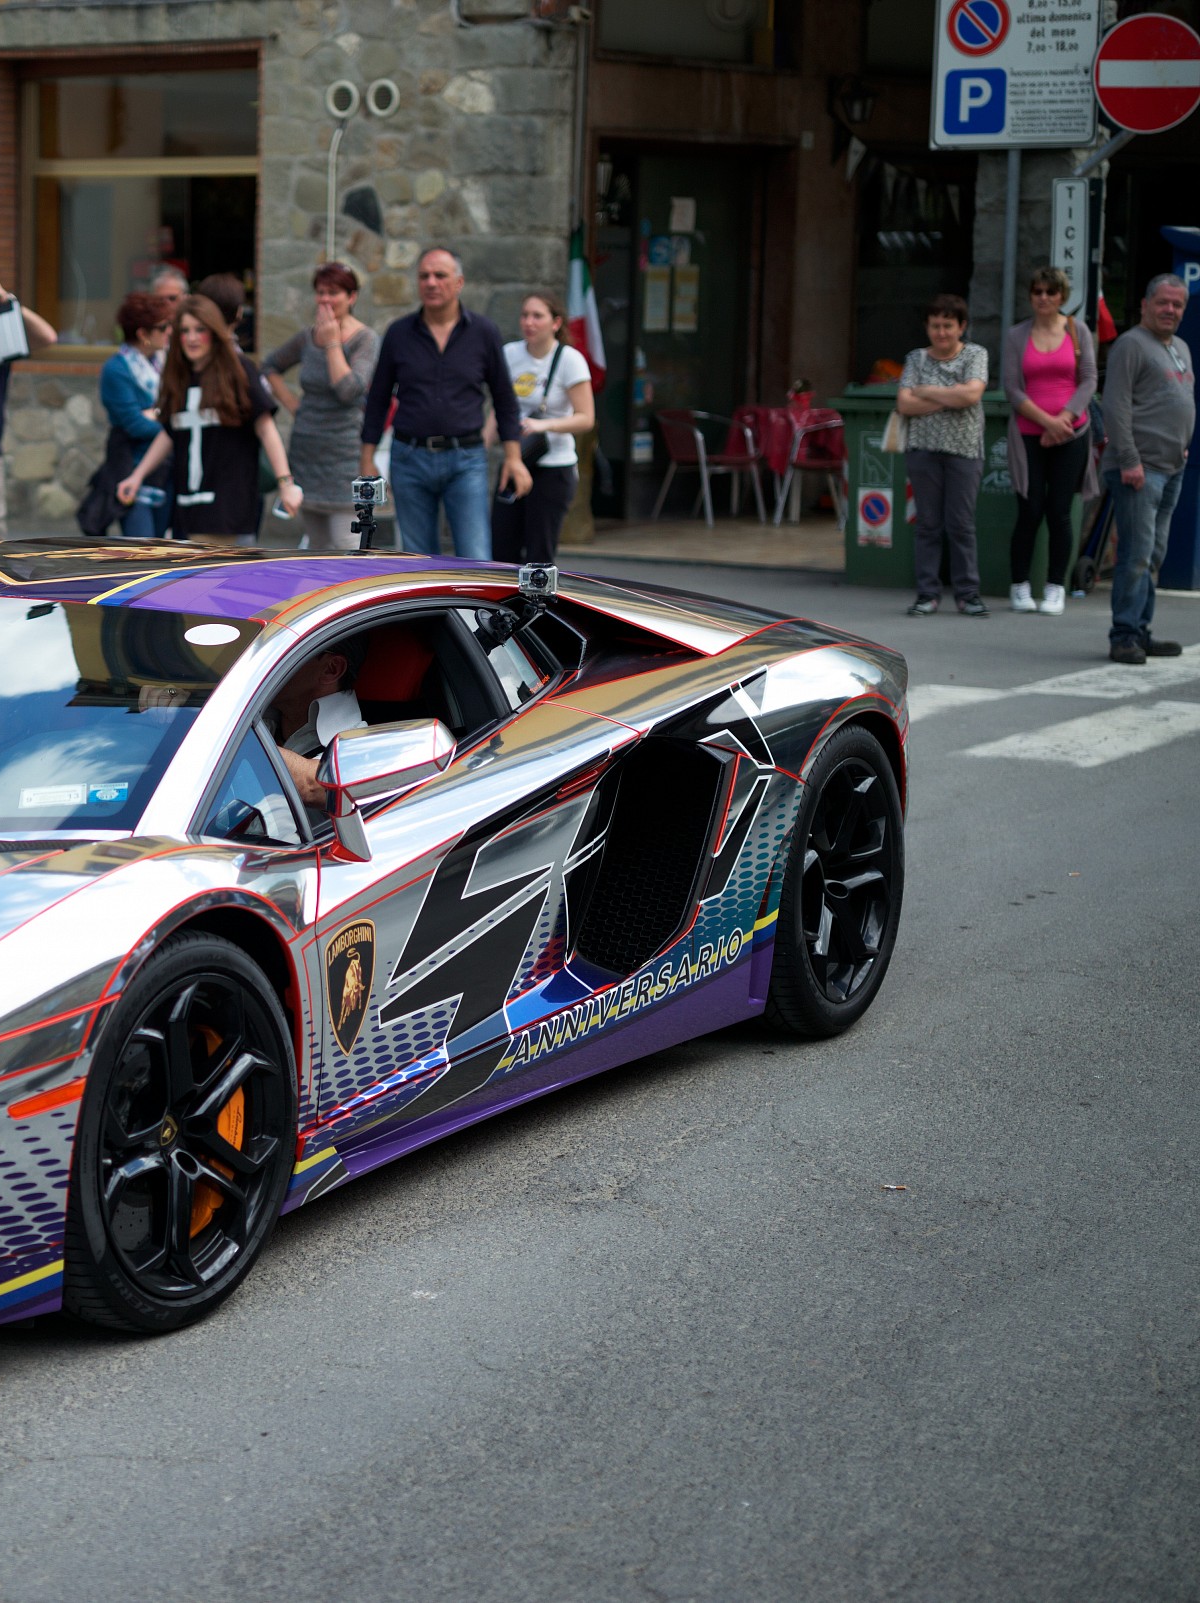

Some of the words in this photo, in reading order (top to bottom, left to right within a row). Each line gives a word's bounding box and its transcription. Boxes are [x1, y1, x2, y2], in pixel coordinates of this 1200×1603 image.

[1016, 13, 1046, 24] ultima
[1048, 11, 1091, 22] domenica
[1030, 27, 1045, 38] del
[1051, 28, 1076, 37] mese
[959, 77, 992, 122] P
[1064, 185, 1075, 290] TICKE
[1184, 262, 1200, 289] P
[328, 926, 372, 967] LAMBORGHINI
[505, 927, 744, 1073] ANNIVERSARIO
